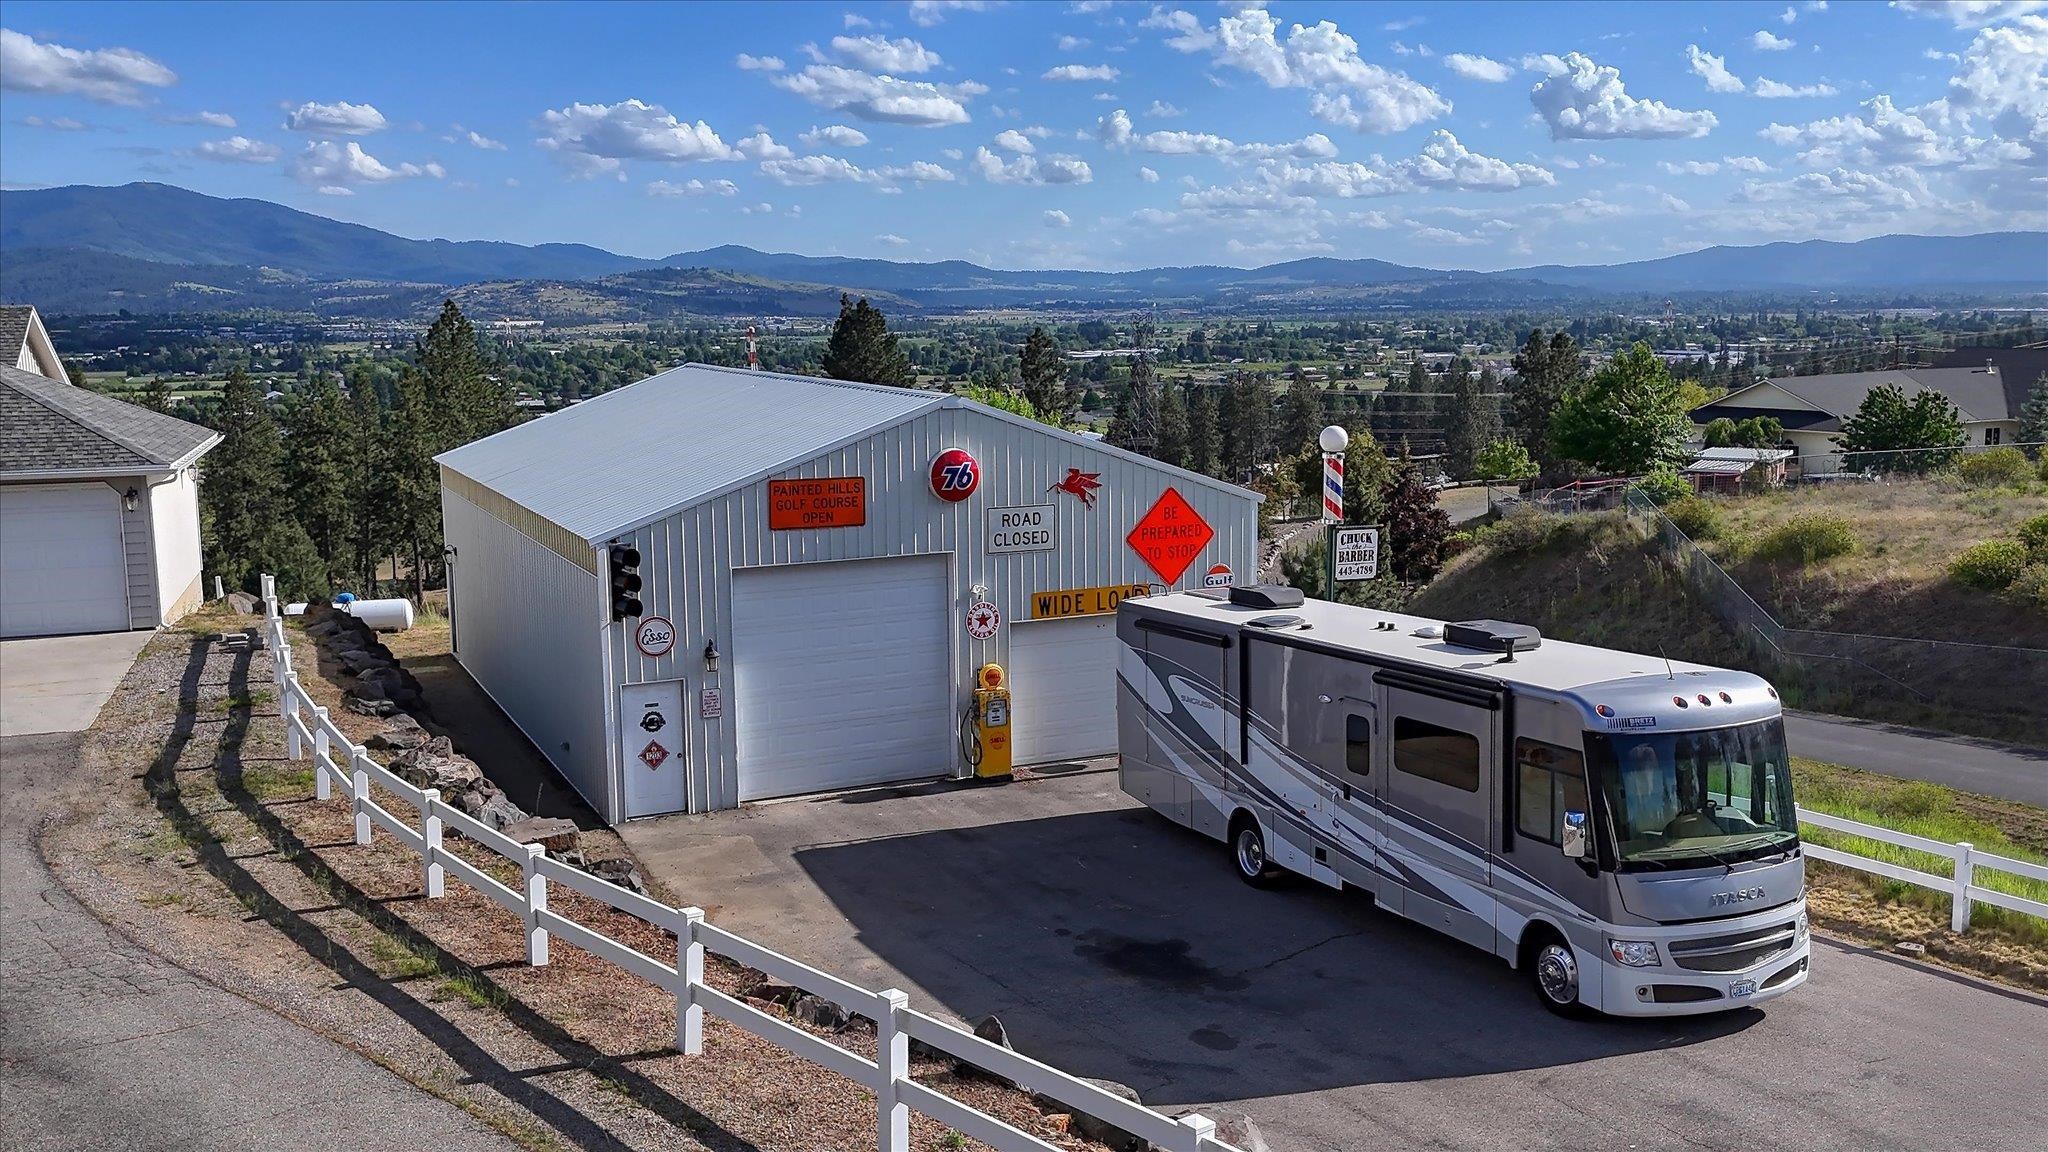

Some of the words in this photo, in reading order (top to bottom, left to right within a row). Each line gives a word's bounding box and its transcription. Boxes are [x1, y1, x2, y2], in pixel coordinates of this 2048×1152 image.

[941, 462, 974, 490] 76
[773, 484, 822, 496] PAINTED
[828, 482, 860, 494] HILLS
[776, 499, 806, 511] GOLF
[813, 496, 858, 509] COURSE
[802, 512, 833, 523] OPEN
[1001, 512, 1041, 527] ROAD
[1163, 507, 1178, 520] BE
[993, 531, 1049, 546] CLOSED
[1142, 524, 1201, 540] PREPARED
[1340, 532, 1372, 545] CHUCK
[1147, 547, 1161, 559] TO
[1168, 544, 1196, 559] STOP
[1338, 550, 1374, 562] BARBER
[1205, 575, 1233, 586] Gulf
[1038, 594, 1084, 616] WIDE
[642, 628, 670, 645] Esso
[1711, 886, 1765, 906] ITASCA
